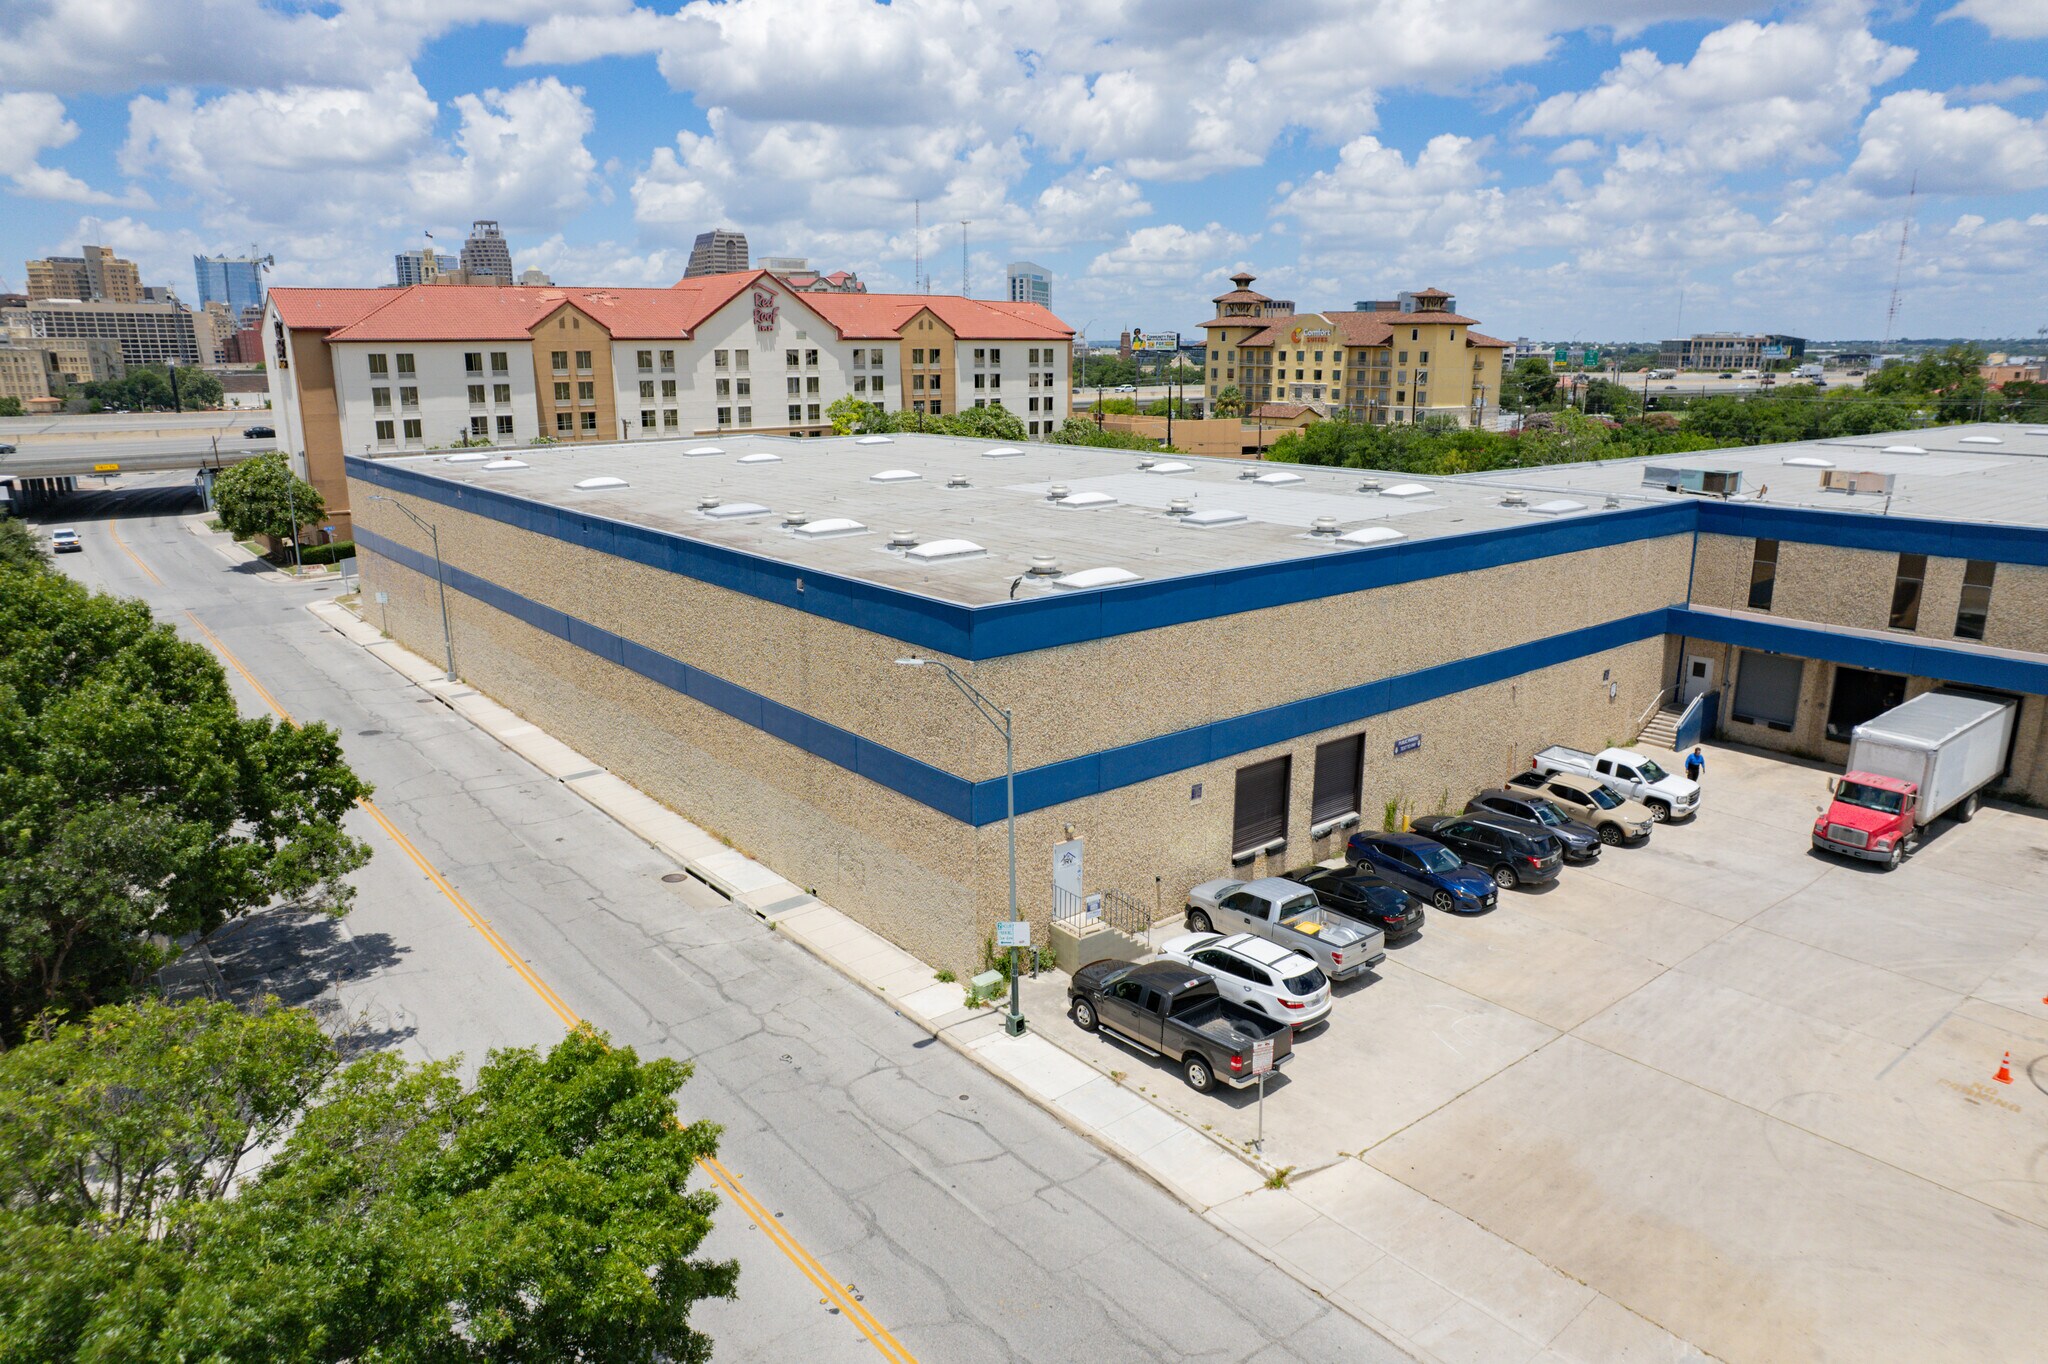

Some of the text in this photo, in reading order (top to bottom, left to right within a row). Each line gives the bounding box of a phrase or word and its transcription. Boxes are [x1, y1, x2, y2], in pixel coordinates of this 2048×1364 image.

[754, 292, 774, 307] Red
[753, 307, 779, 324] Roof
[1303, 328, 1331, 336] Comfort
[1971, 1082, 1999, 1096] NO
